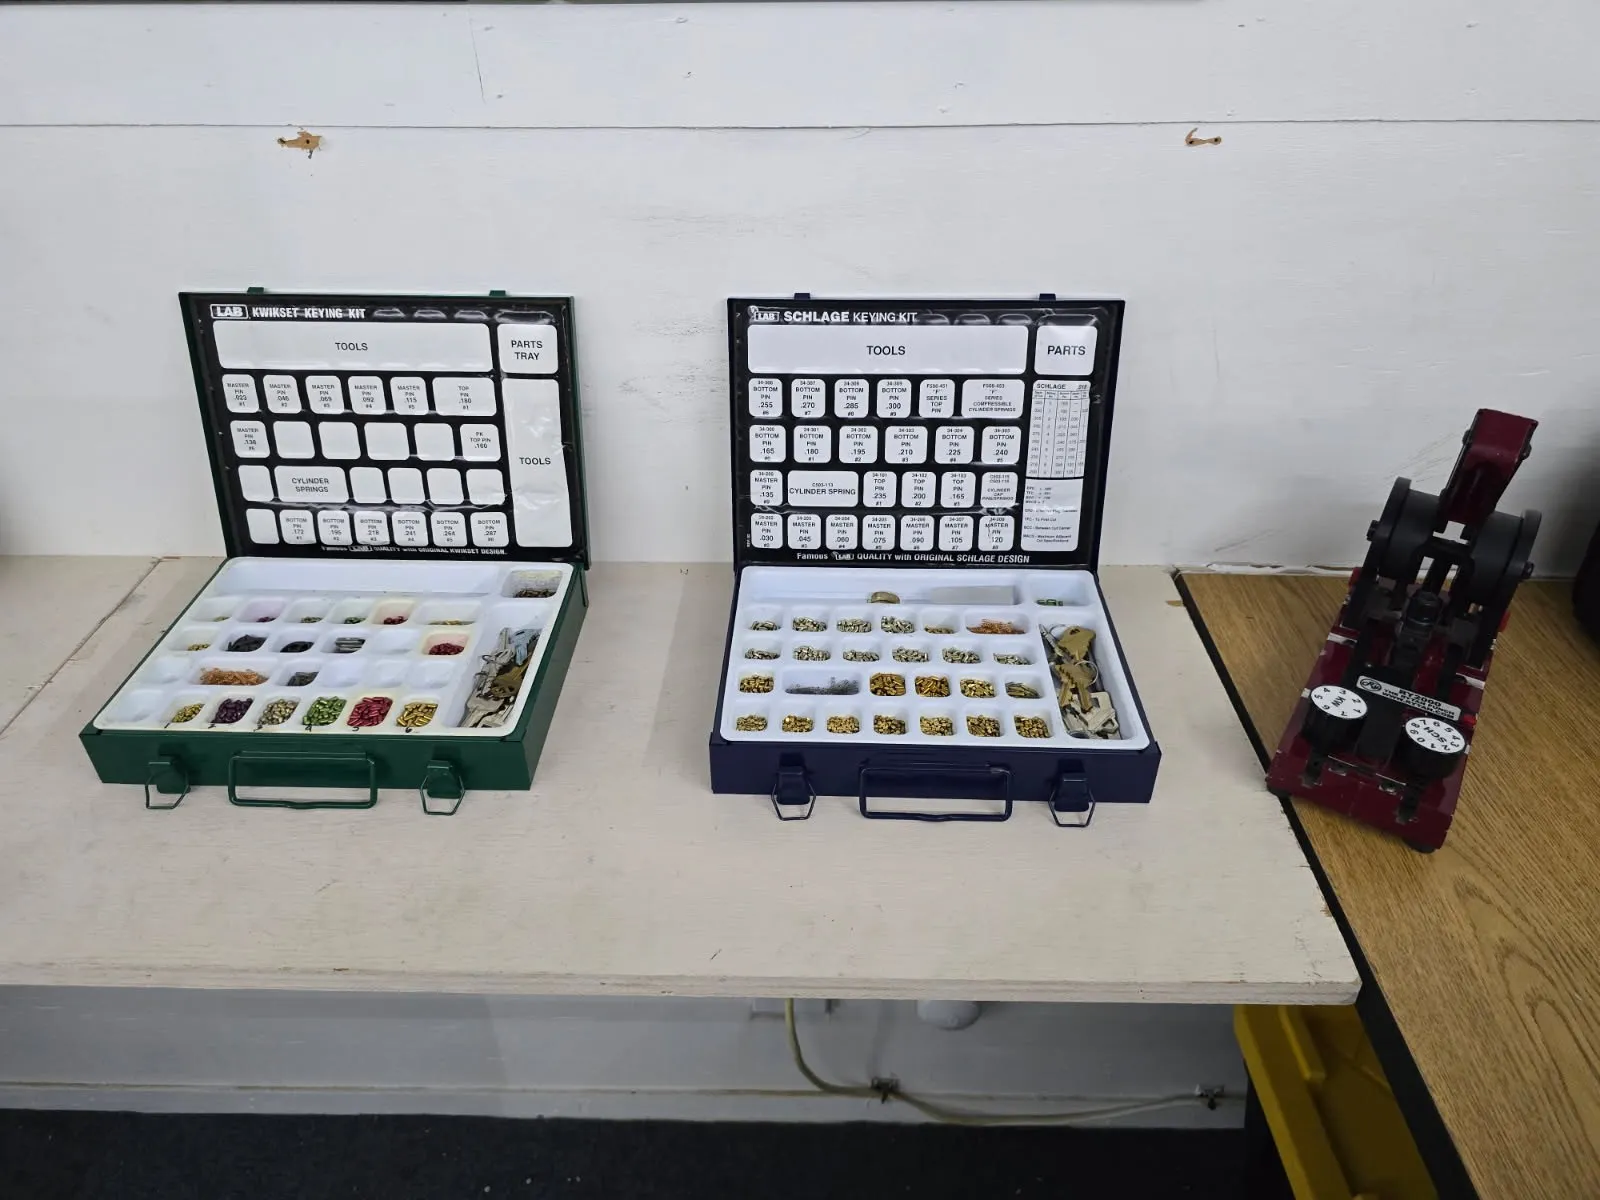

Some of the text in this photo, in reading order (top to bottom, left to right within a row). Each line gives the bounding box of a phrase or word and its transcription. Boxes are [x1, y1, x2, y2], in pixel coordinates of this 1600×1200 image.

[216, 307, 366, 318] LAB KWIKSET KEYING KIT
[784, 311, 849, 322] SCHLAGE
[853, 312, 895, 322] KEYING
[899, 312, 918, 322] KIT
[335, 342, 368, 352] TOOLS
[511, 340, 543, 349] PARTS
[514, 351, 540, 361] TRAY
[866, 345, 906, 356] TOOLS
[1047, 345, 1086, 356] PARTS
[957, 554, 995, 562] SCHLAGE
[998, 555, 1030, 563] DESIGN
[1331, 696, 1346, 707] KW
[1424, 727, 1447, 743] SCH
